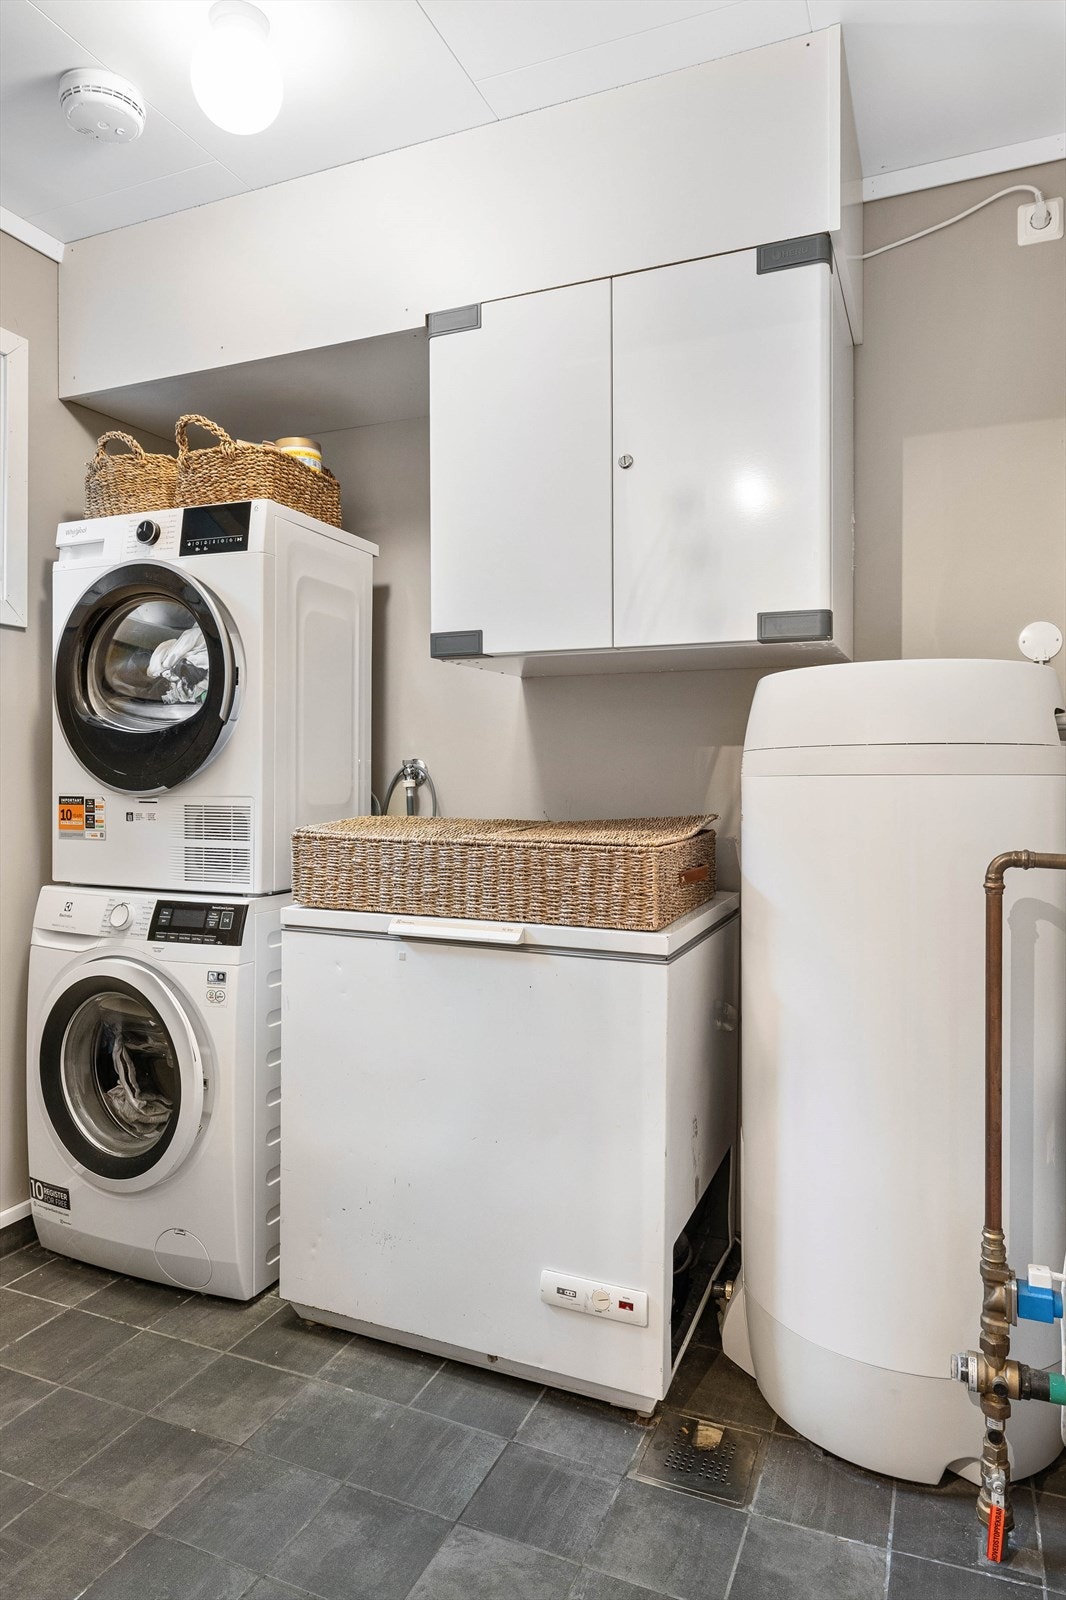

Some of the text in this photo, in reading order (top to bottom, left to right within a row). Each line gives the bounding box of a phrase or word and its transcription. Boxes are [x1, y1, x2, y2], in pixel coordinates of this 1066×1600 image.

[60, 808, 72, 821] 10
[30, 1179, 44, 1200] 10
[43, 1187, 68, 1200] REGISTER
[43, 1195, 68, 1209] FOR FREE
